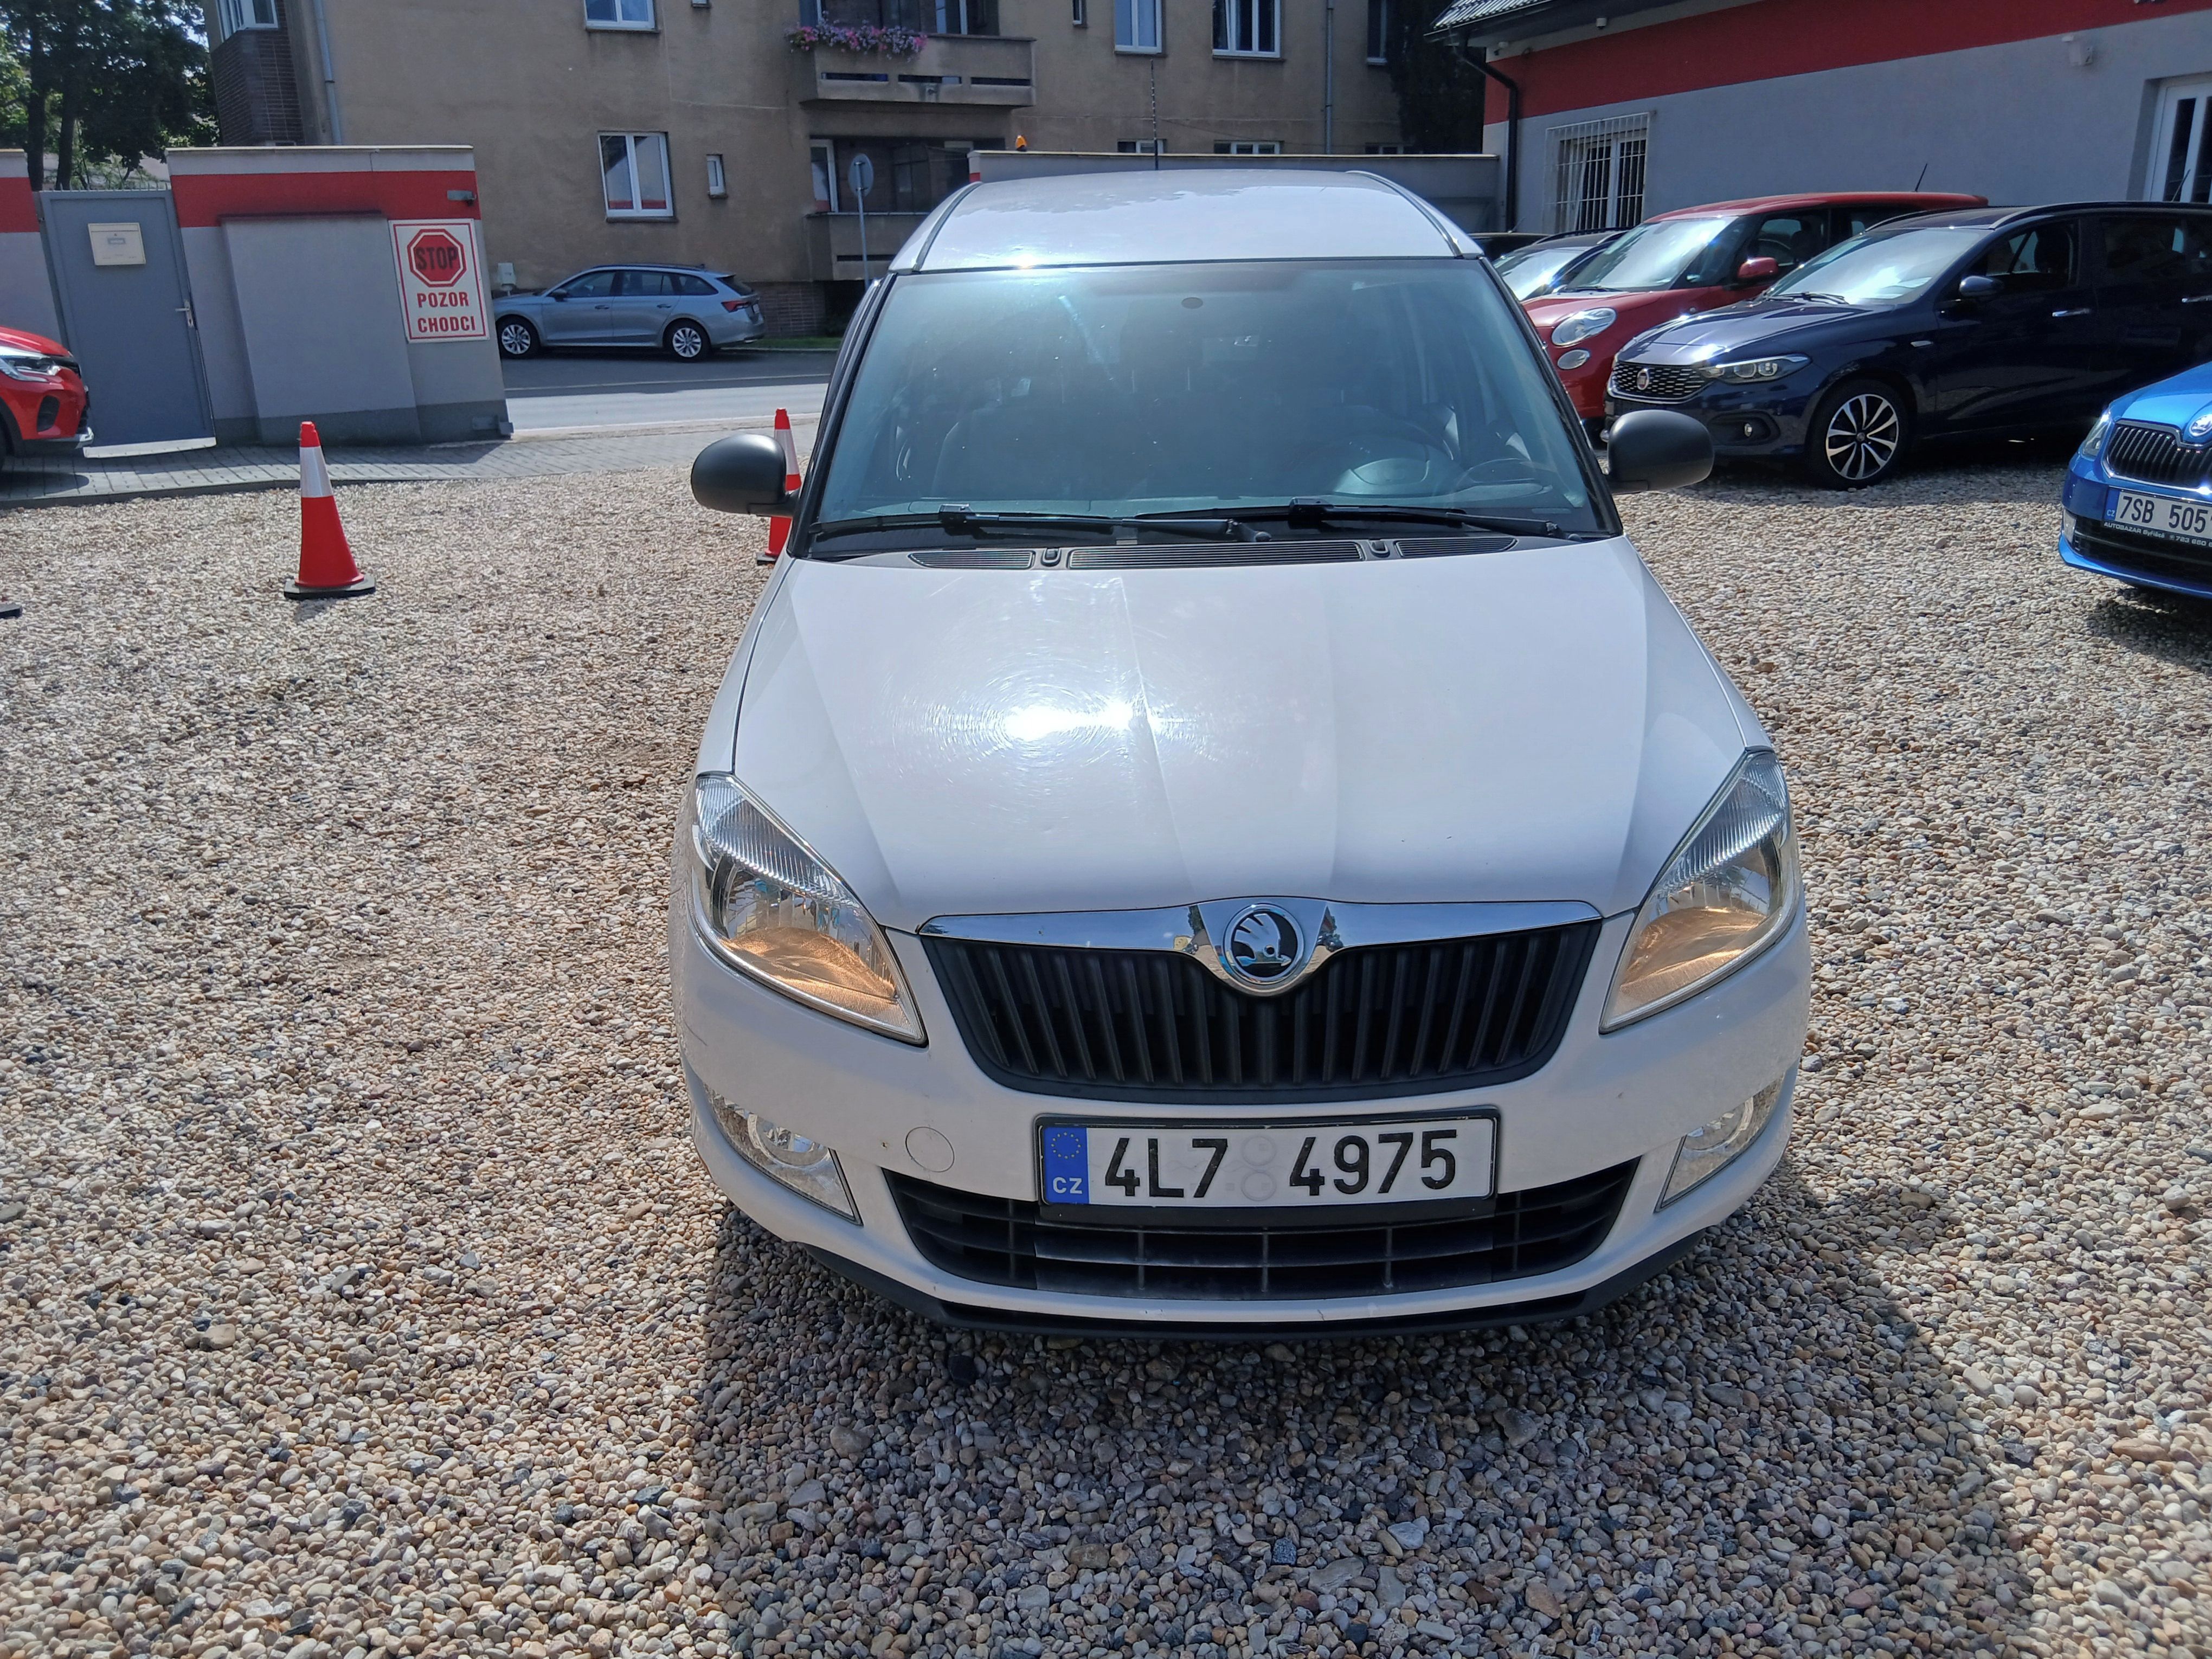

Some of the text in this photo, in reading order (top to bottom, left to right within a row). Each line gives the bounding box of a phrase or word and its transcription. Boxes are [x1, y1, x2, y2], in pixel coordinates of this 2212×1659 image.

[416, 247, 458, 270] STOP
[417, 292, 469, 308] POZOR
[417, 316, 475, 332] CHODCI
[2120, 496, 2155, 523] 7SB
[2169, 504, 2212, 533] 505
[2104, 522, 2141, 534] AUTOBAZAR
[1052, 1129, 1457, 1198] CZ 4L7 4975
